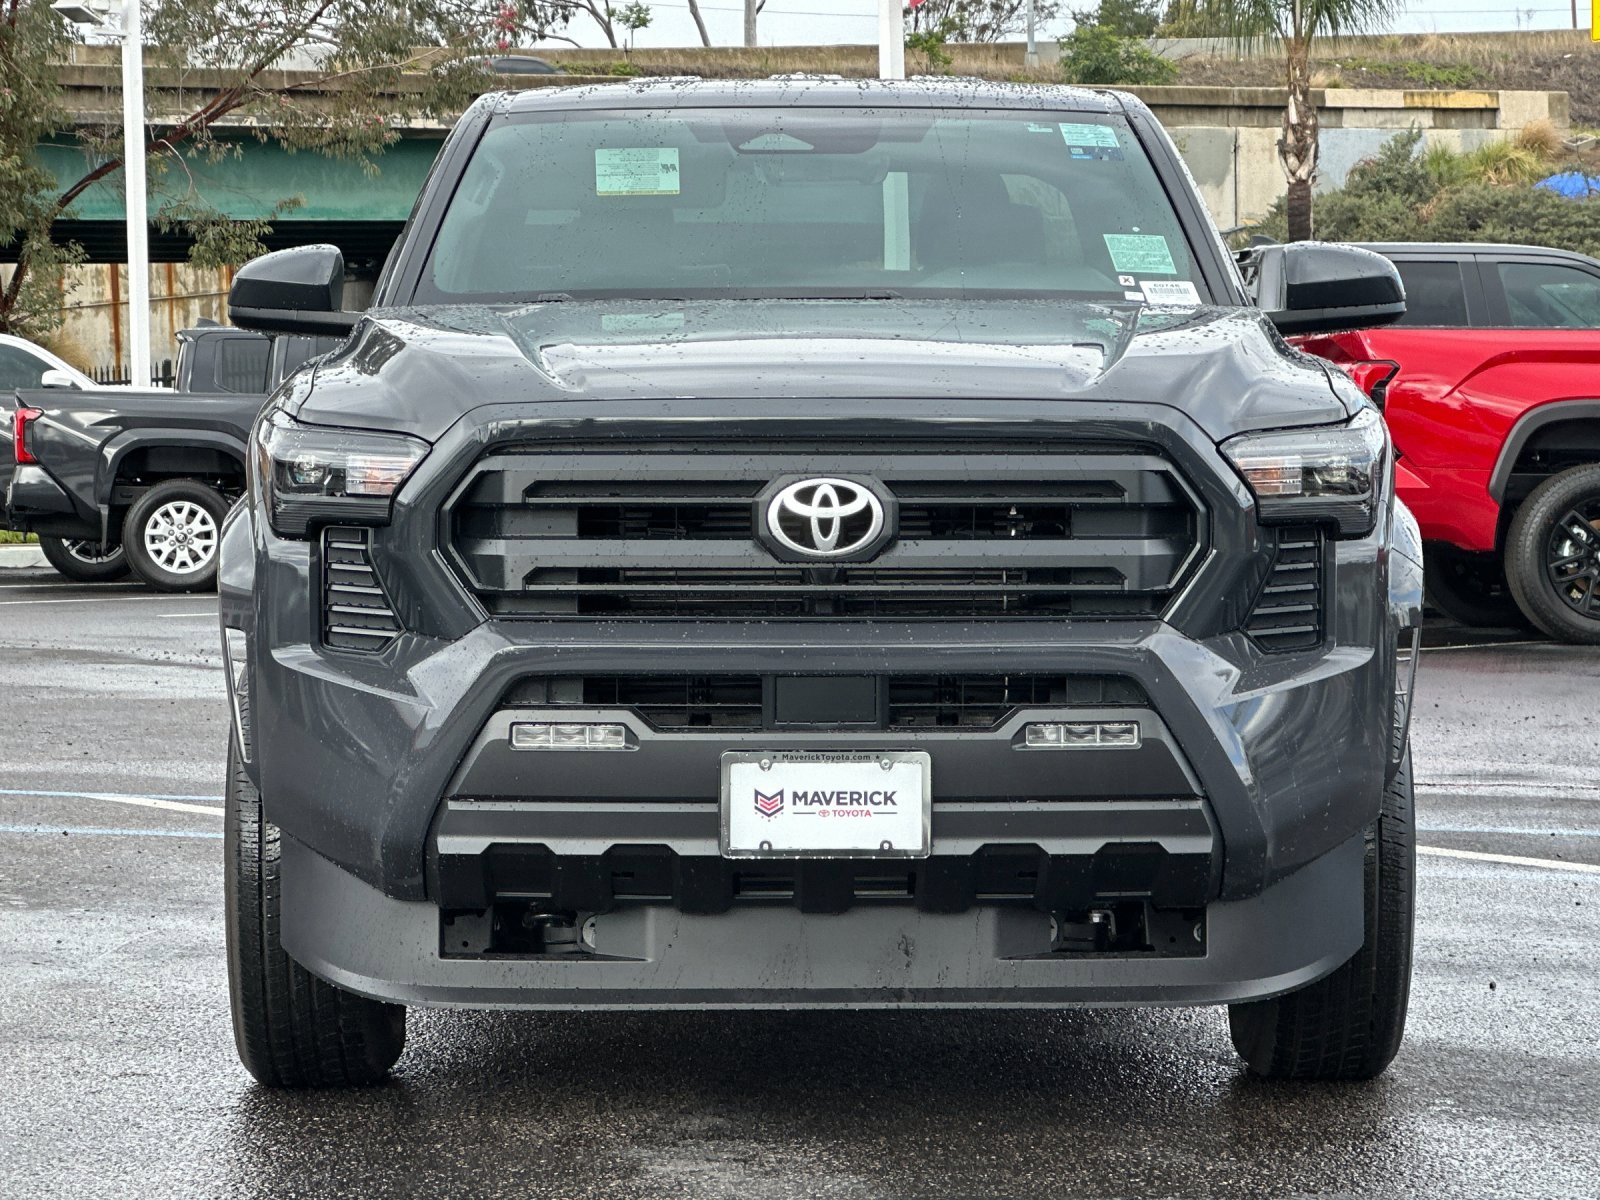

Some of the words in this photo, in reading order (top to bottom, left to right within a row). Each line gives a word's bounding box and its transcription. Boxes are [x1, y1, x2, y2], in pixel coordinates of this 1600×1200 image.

[781, 753, 871, 762] MaverickToyota.com
[792, 790, 898, 806] MAVERICK
[831, 809, 872, 818] TOYOTA
